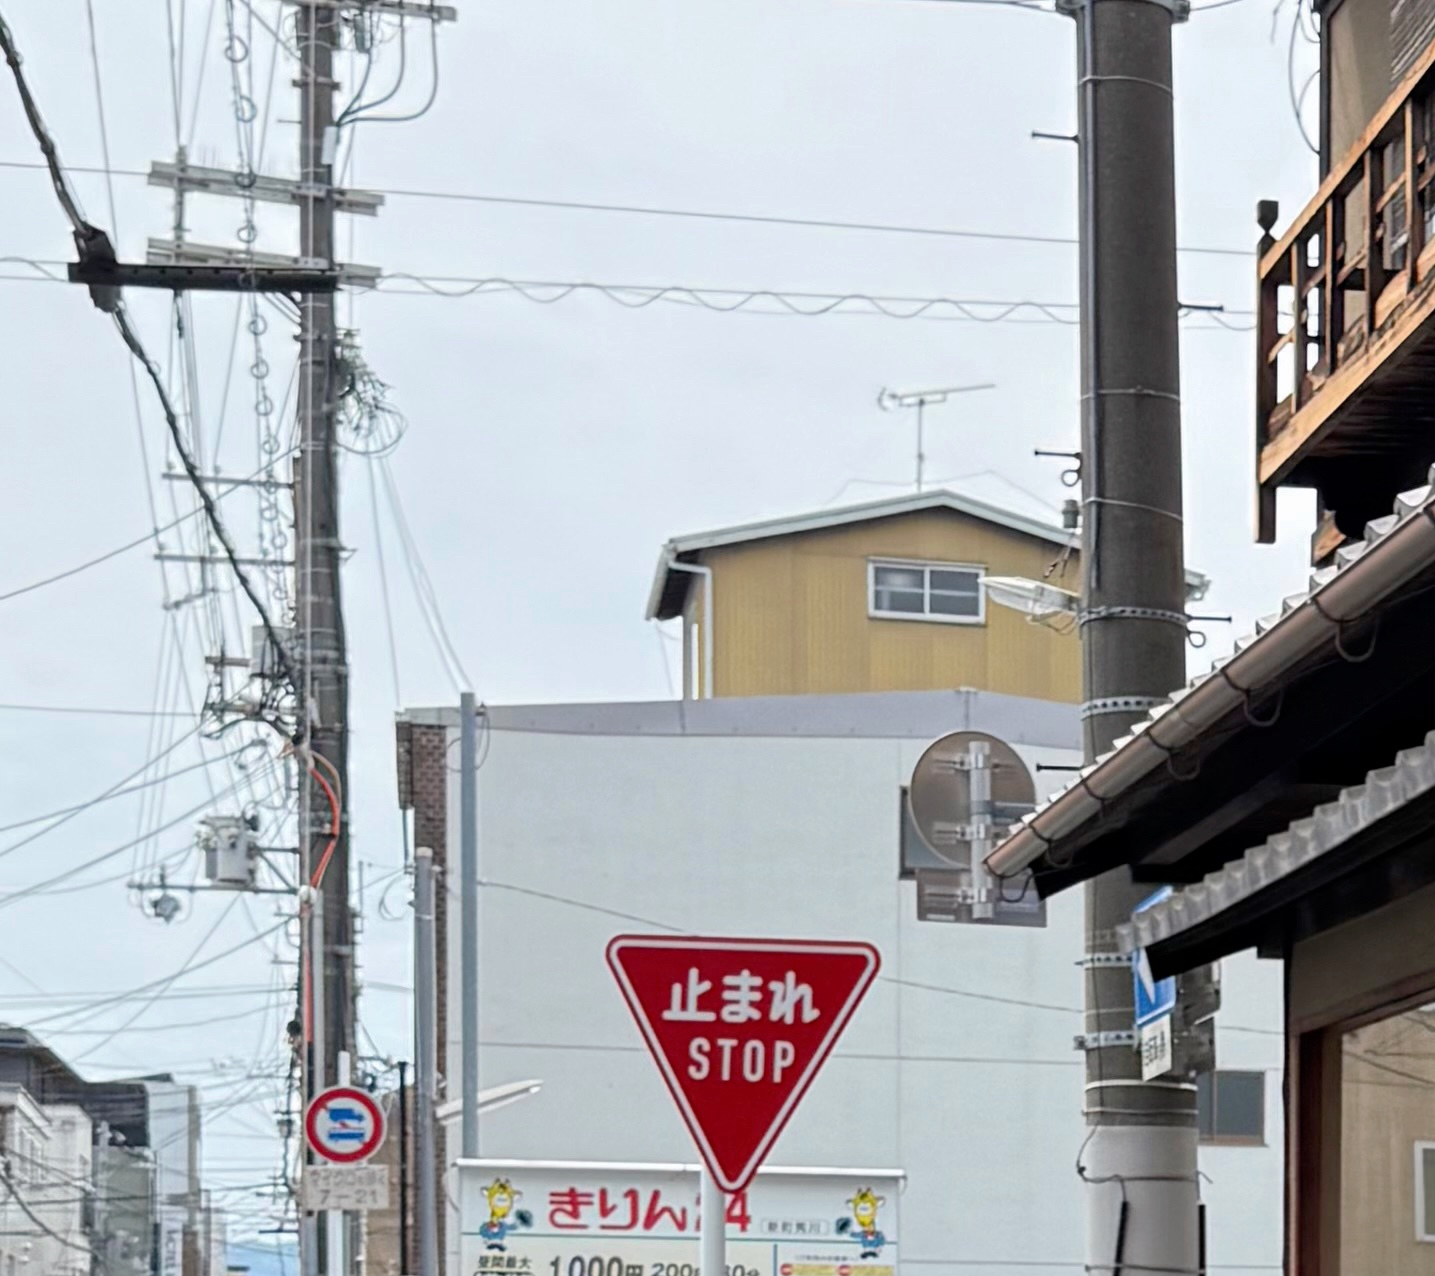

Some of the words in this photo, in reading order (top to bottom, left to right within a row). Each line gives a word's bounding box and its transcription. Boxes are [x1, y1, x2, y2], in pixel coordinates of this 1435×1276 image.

[662, 967, 820, 1024] 止まれ
[688, 1037, 795, 1083] STOP
[548, 1187, 752, 1233] きりん4
